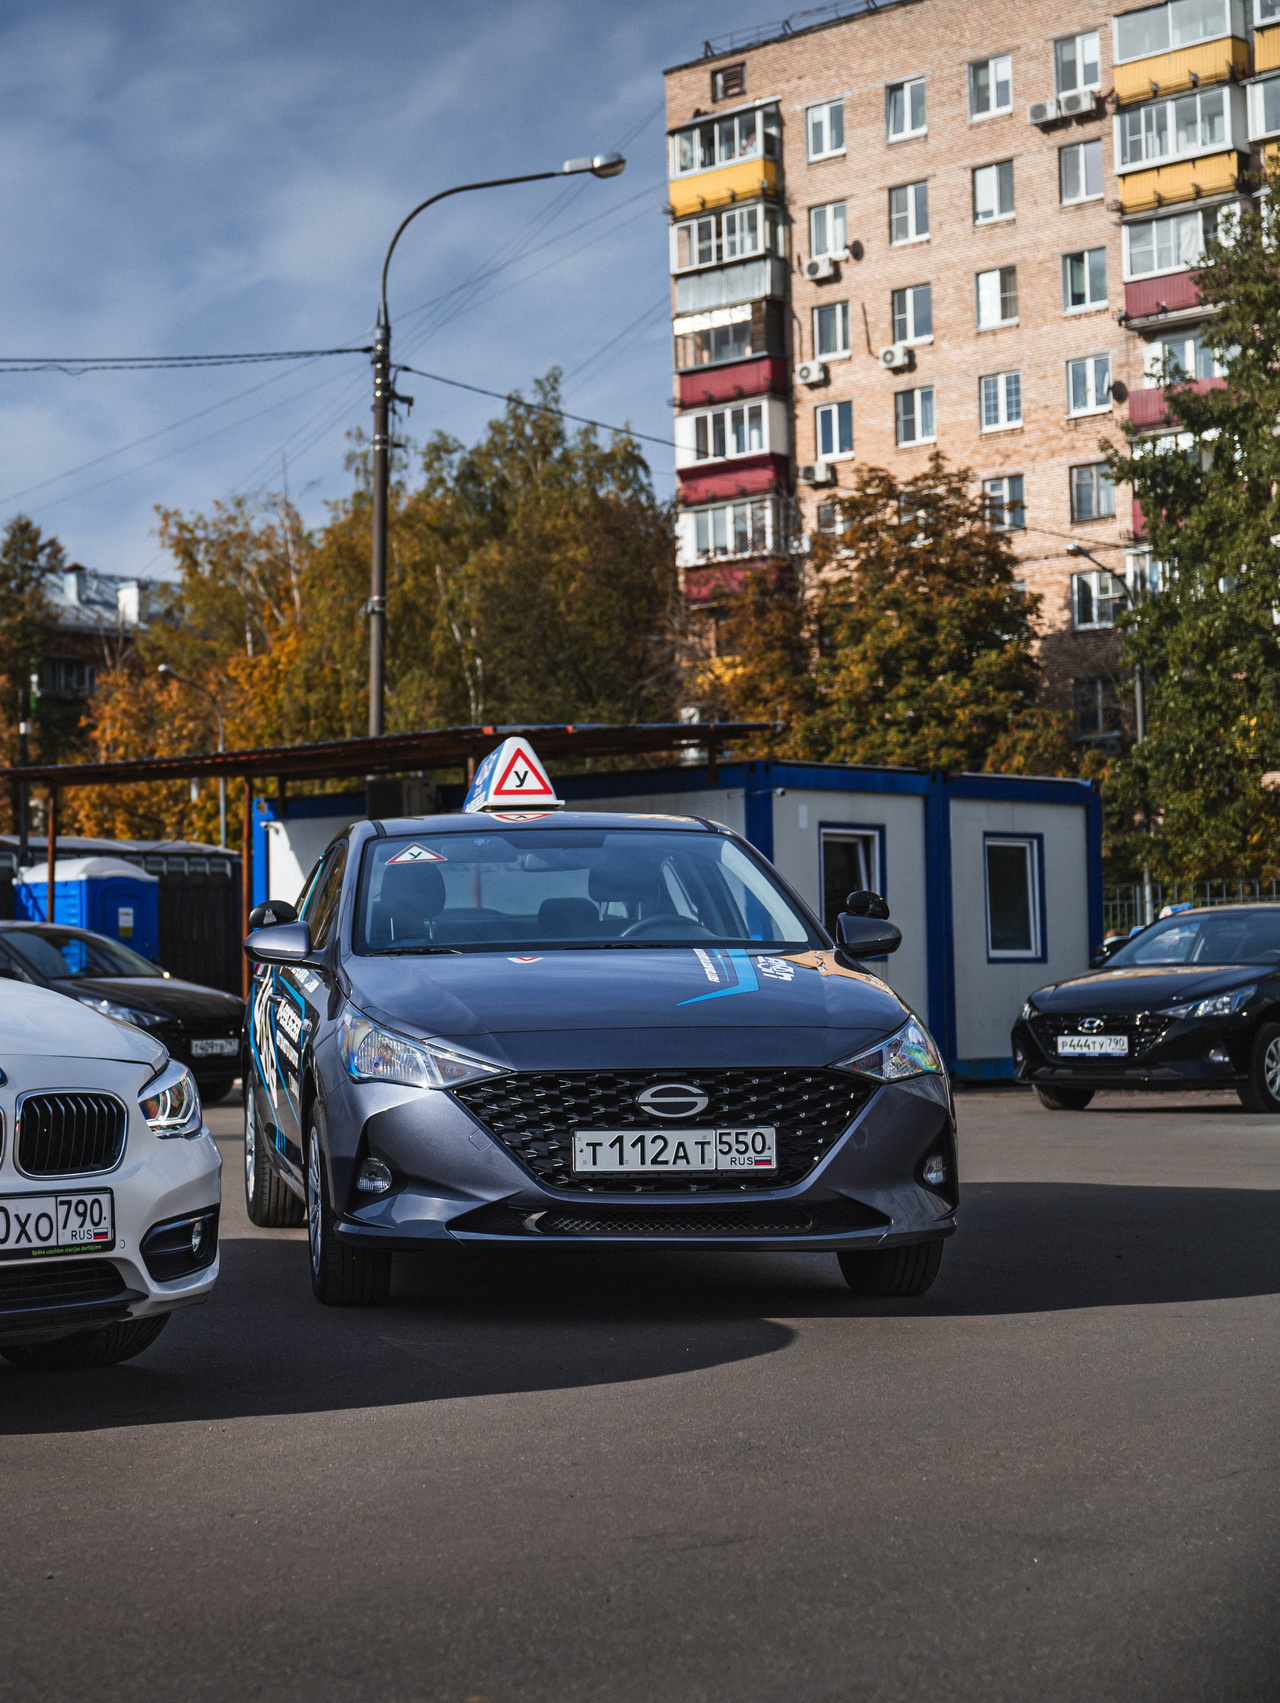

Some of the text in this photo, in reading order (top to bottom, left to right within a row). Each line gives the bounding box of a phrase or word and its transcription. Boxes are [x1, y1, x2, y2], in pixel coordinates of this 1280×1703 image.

[513, 770, 529, 788] У
[1061, 1037, 1125, 1050] Р444ТУ 790
[585, 1132, 767, 1166] Т112АТ 550
[730, 1156, 754, 1166] RUS
[58, 1198, 104, 1230] 790
[71, 1229, 93, 1241] RUS
